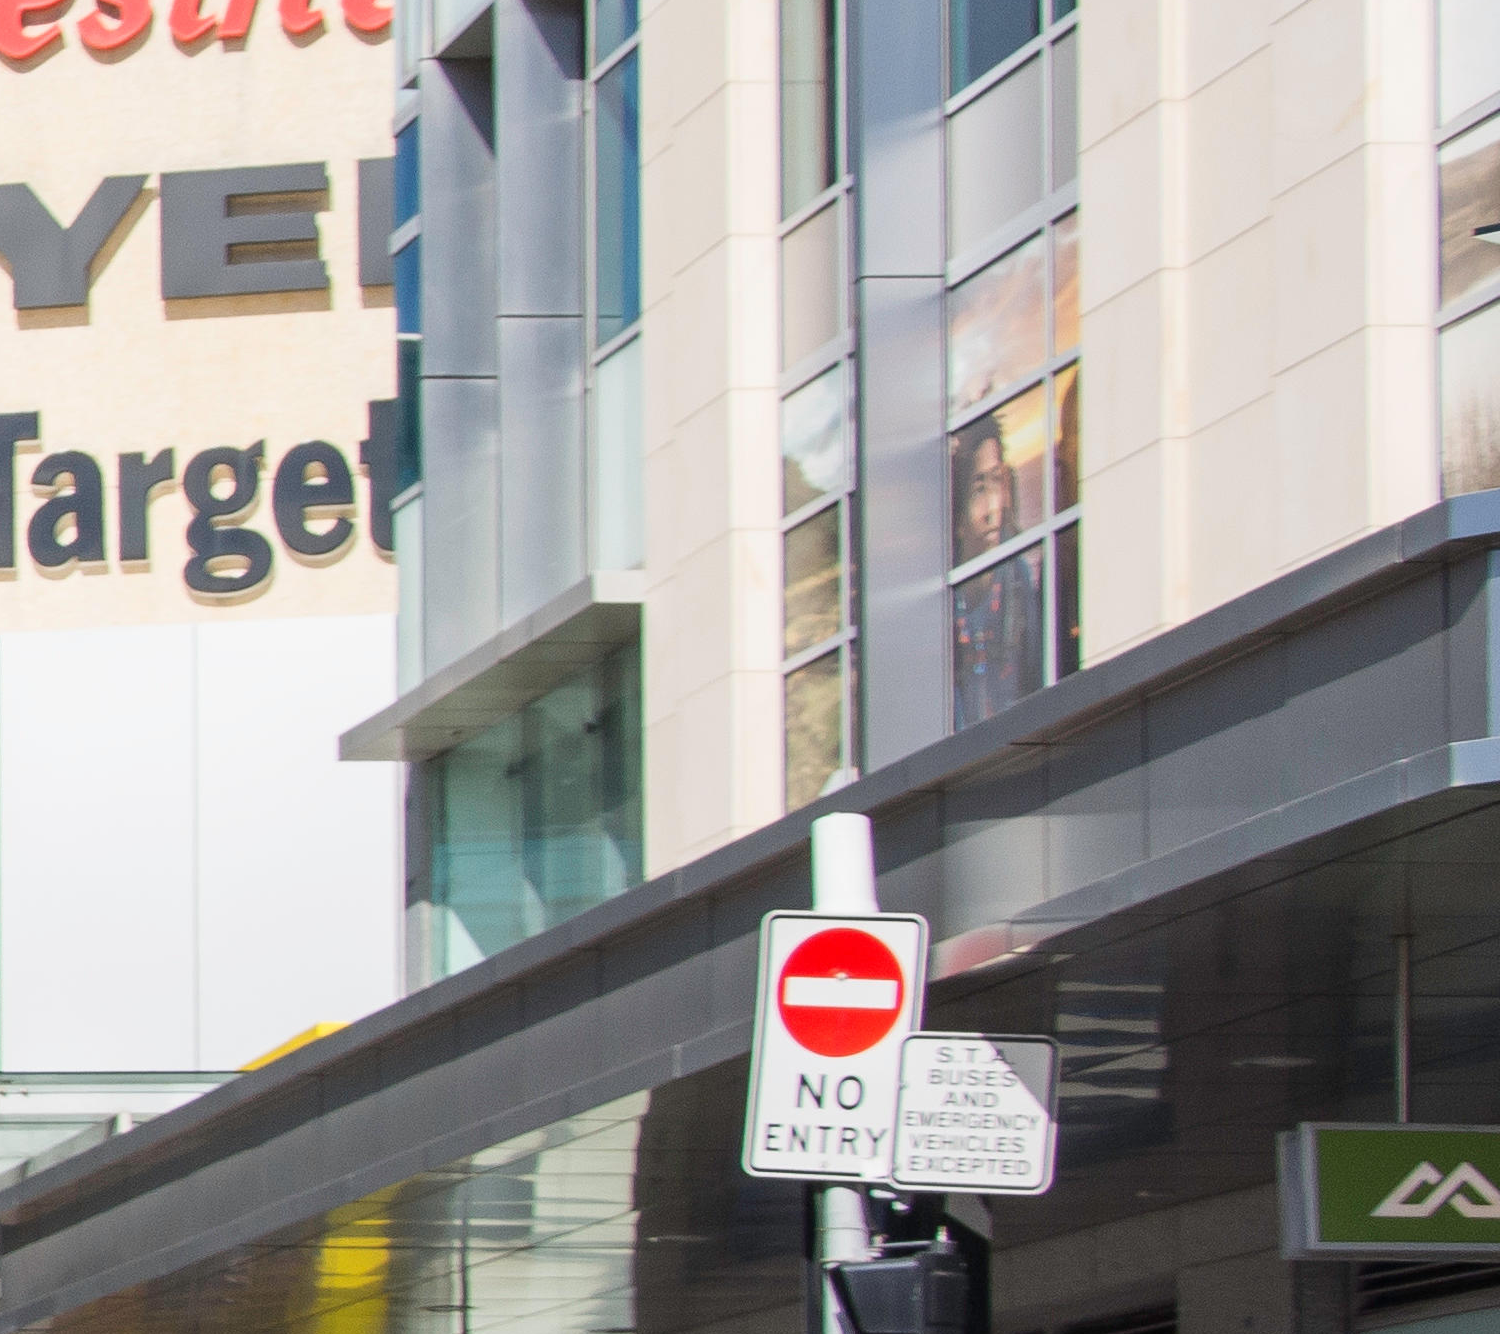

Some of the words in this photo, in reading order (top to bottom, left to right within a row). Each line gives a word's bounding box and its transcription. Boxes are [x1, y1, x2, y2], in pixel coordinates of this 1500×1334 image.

[928, 1068, 1018, 1088] BUSES
[798, 1074, 864, 1110] NO
[943, 1091, 999, 1108] AND
[904, 1110, 1042, 1131] EMERGENCY
[765, 1124, 889, 1158] ENTRY
[909, 1134, 1026, 1153] VEHICLES
[909, 1155, 1031, 1176] EXCEPTED
